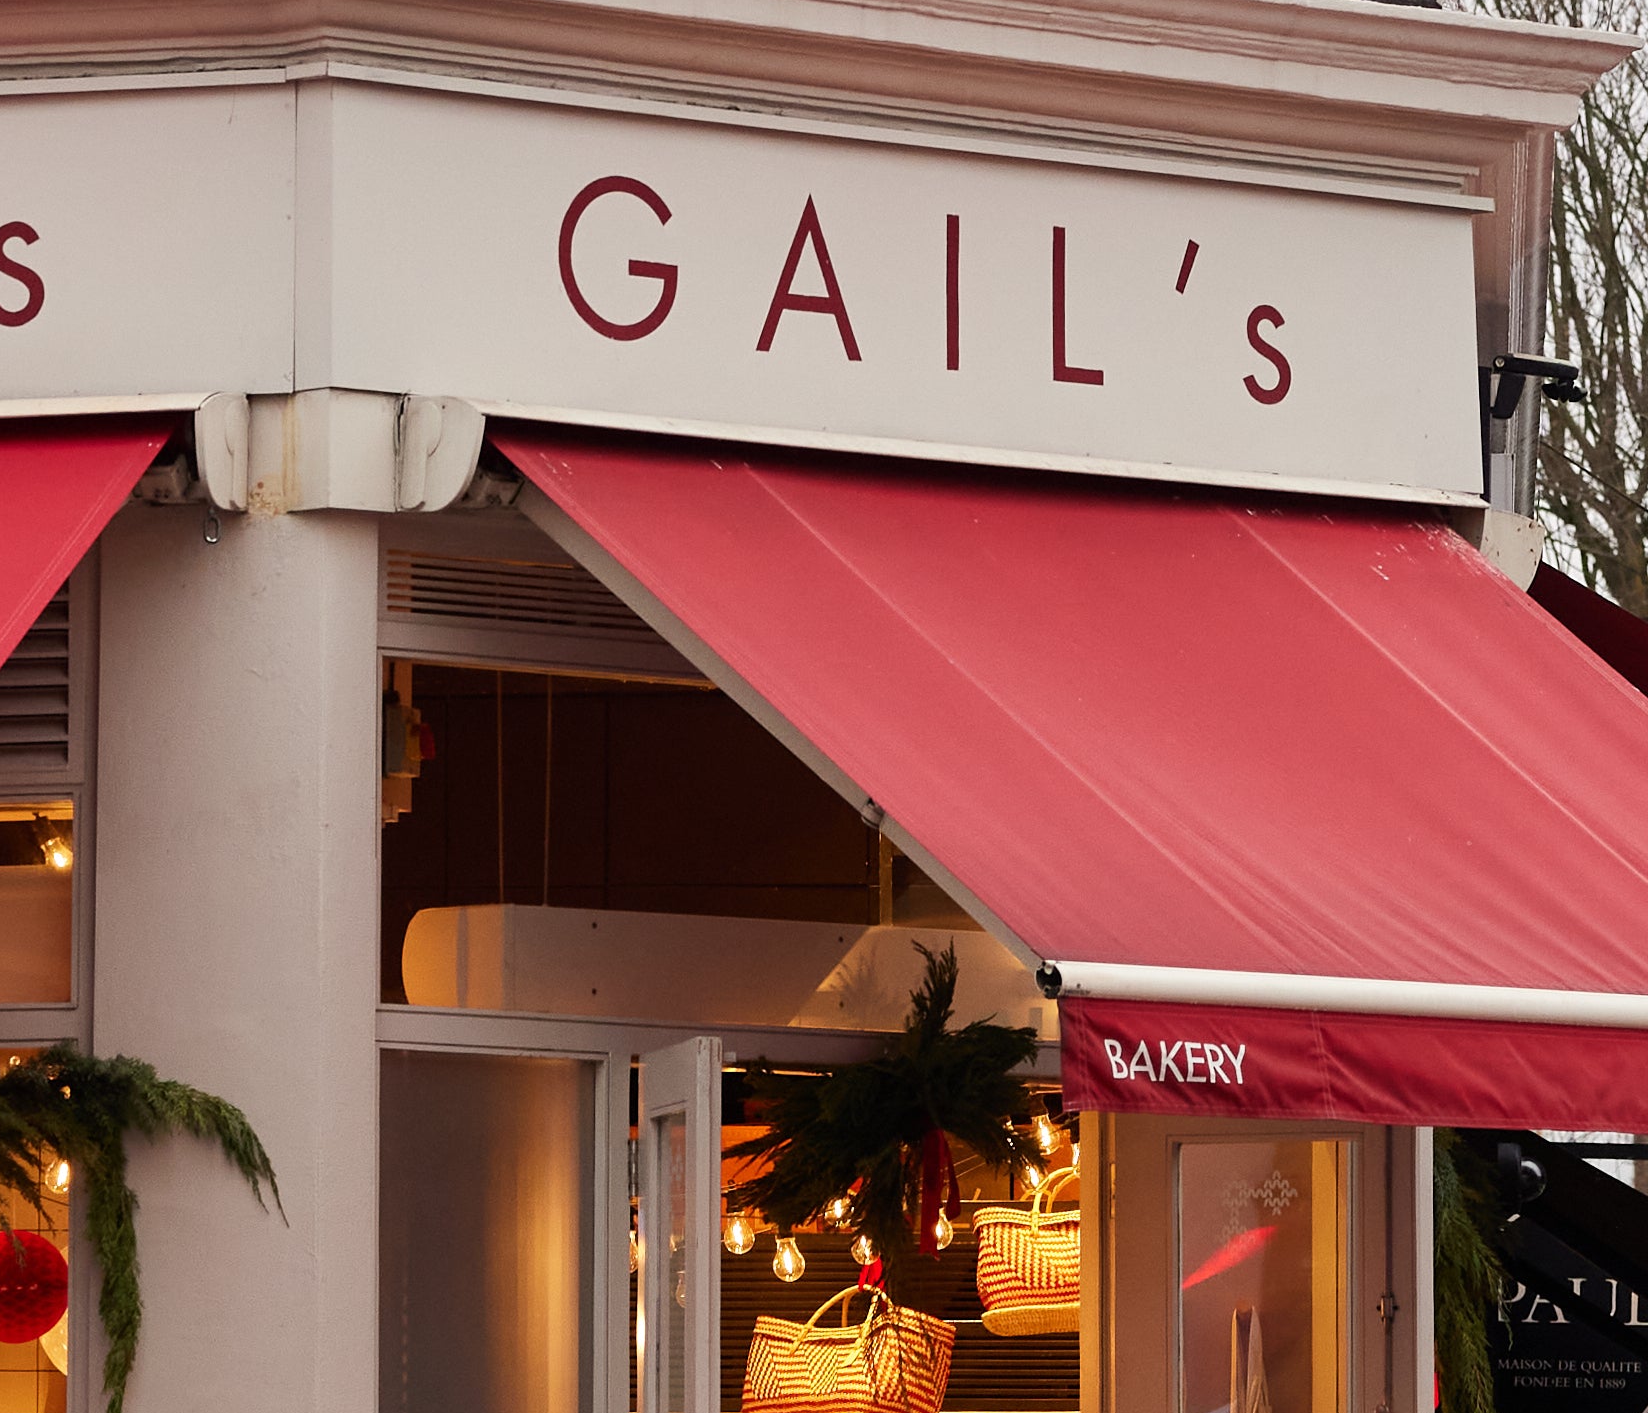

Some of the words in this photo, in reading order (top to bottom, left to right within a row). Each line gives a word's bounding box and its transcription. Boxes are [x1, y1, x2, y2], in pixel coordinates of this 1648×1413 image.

[557, 175, 1292, 406] GAIL's
[1103, 1039, 1246, 1086] BAKERY
[1498, 1359, 1552, 1371] MAISON
[1558, 1360, 1577, 1371] DE
[1575, 1377, 1594, 1388] EN
[1599, 1378, 1626, 1389] 1889
